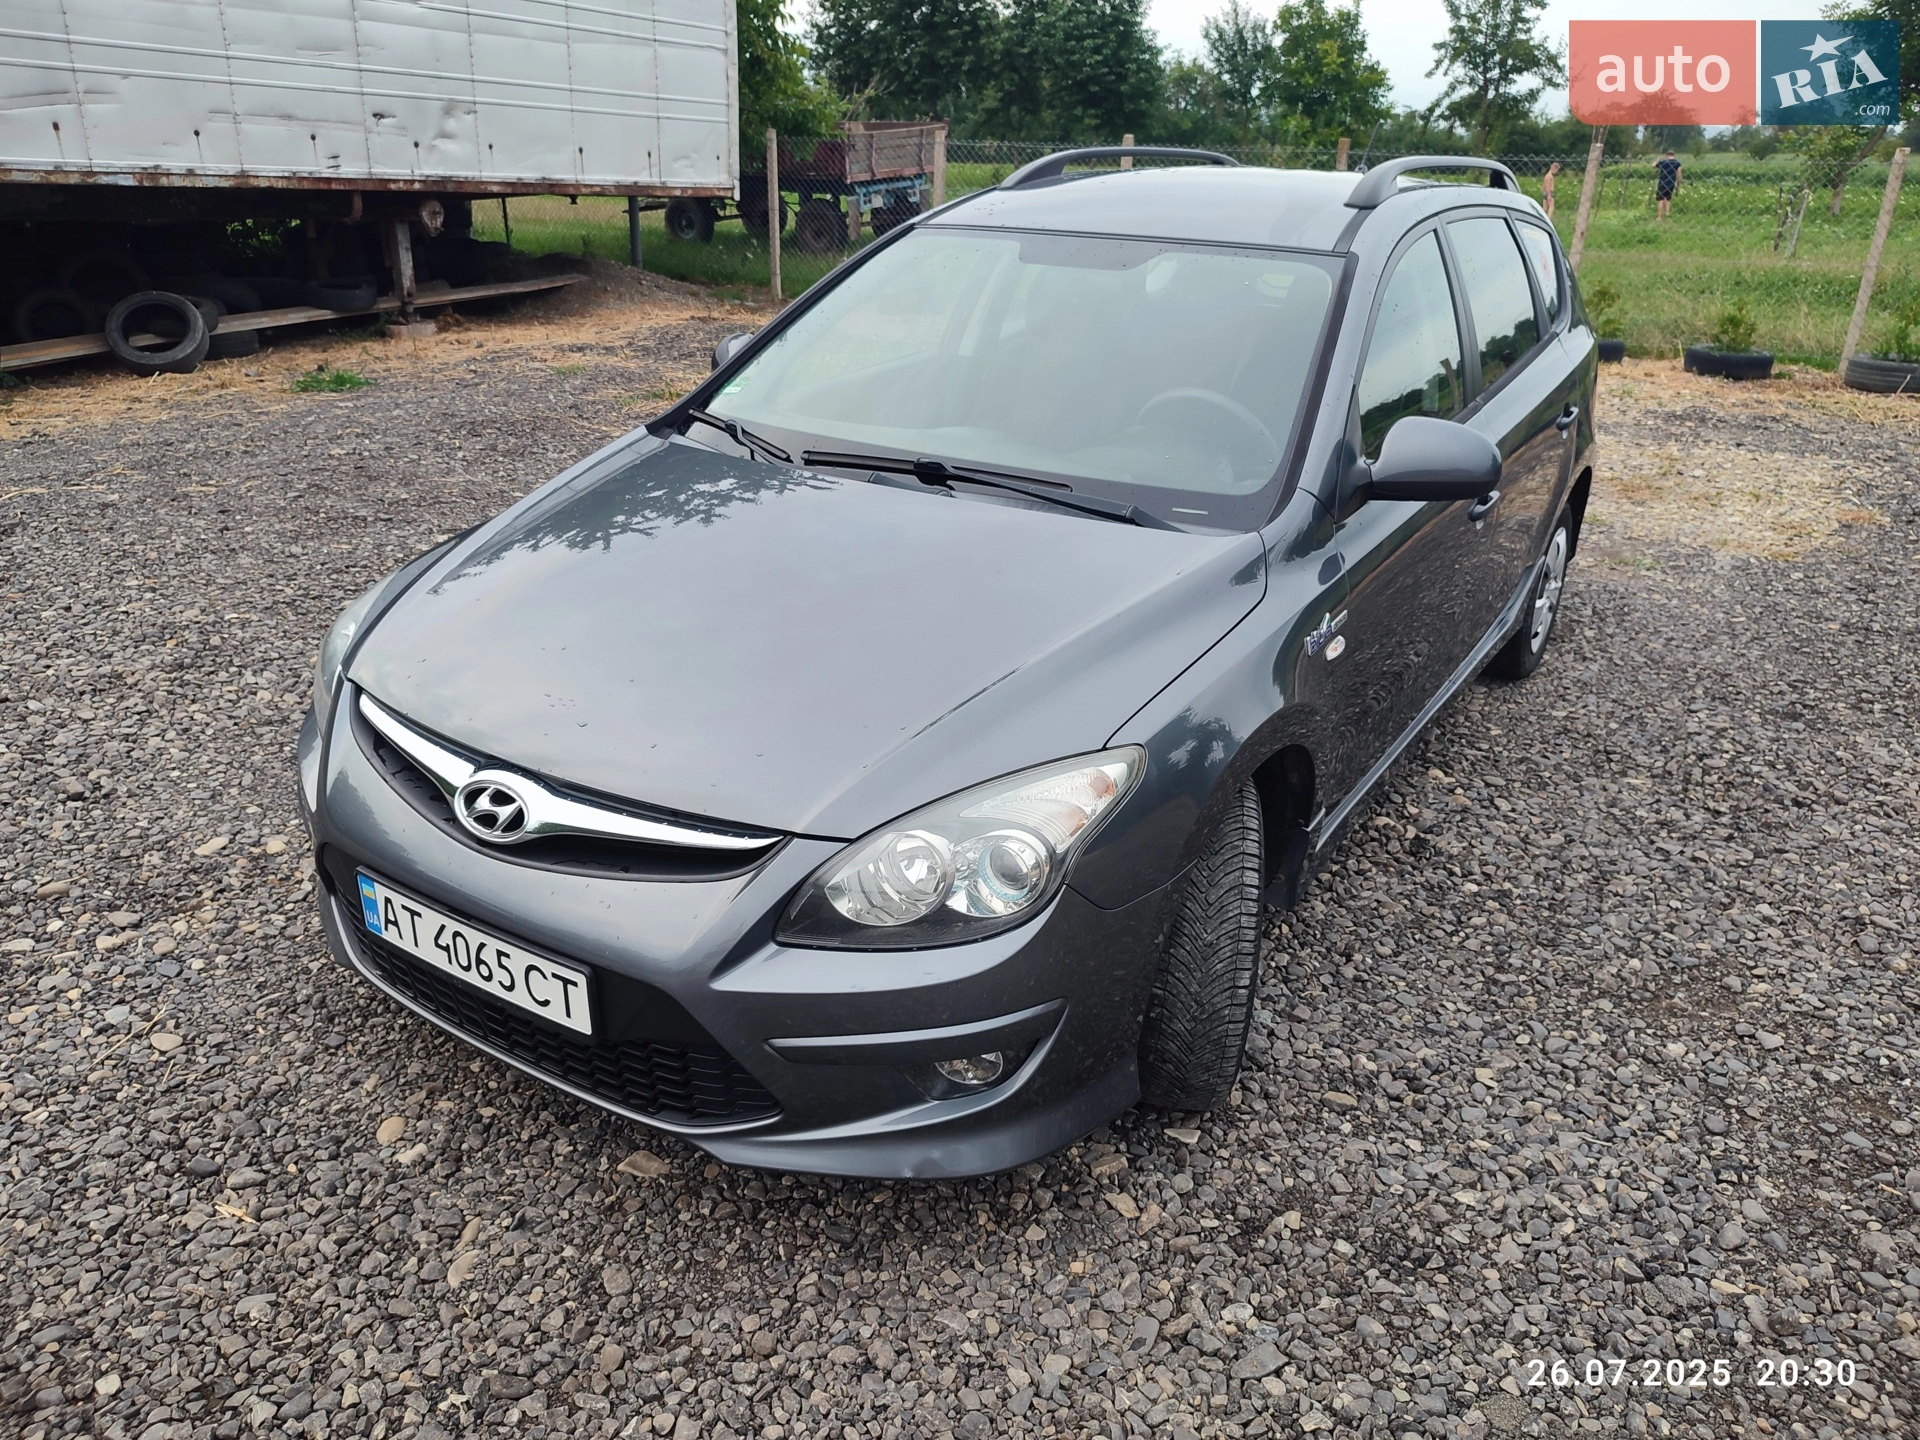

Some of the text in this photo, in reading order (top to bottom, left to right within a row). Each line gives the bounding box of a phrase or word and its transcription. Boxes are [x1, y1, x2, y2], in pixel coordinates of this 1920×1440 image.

[366, 910, 381, 928] UA
[383, 896, 578, 1019] AT 4065 CT
